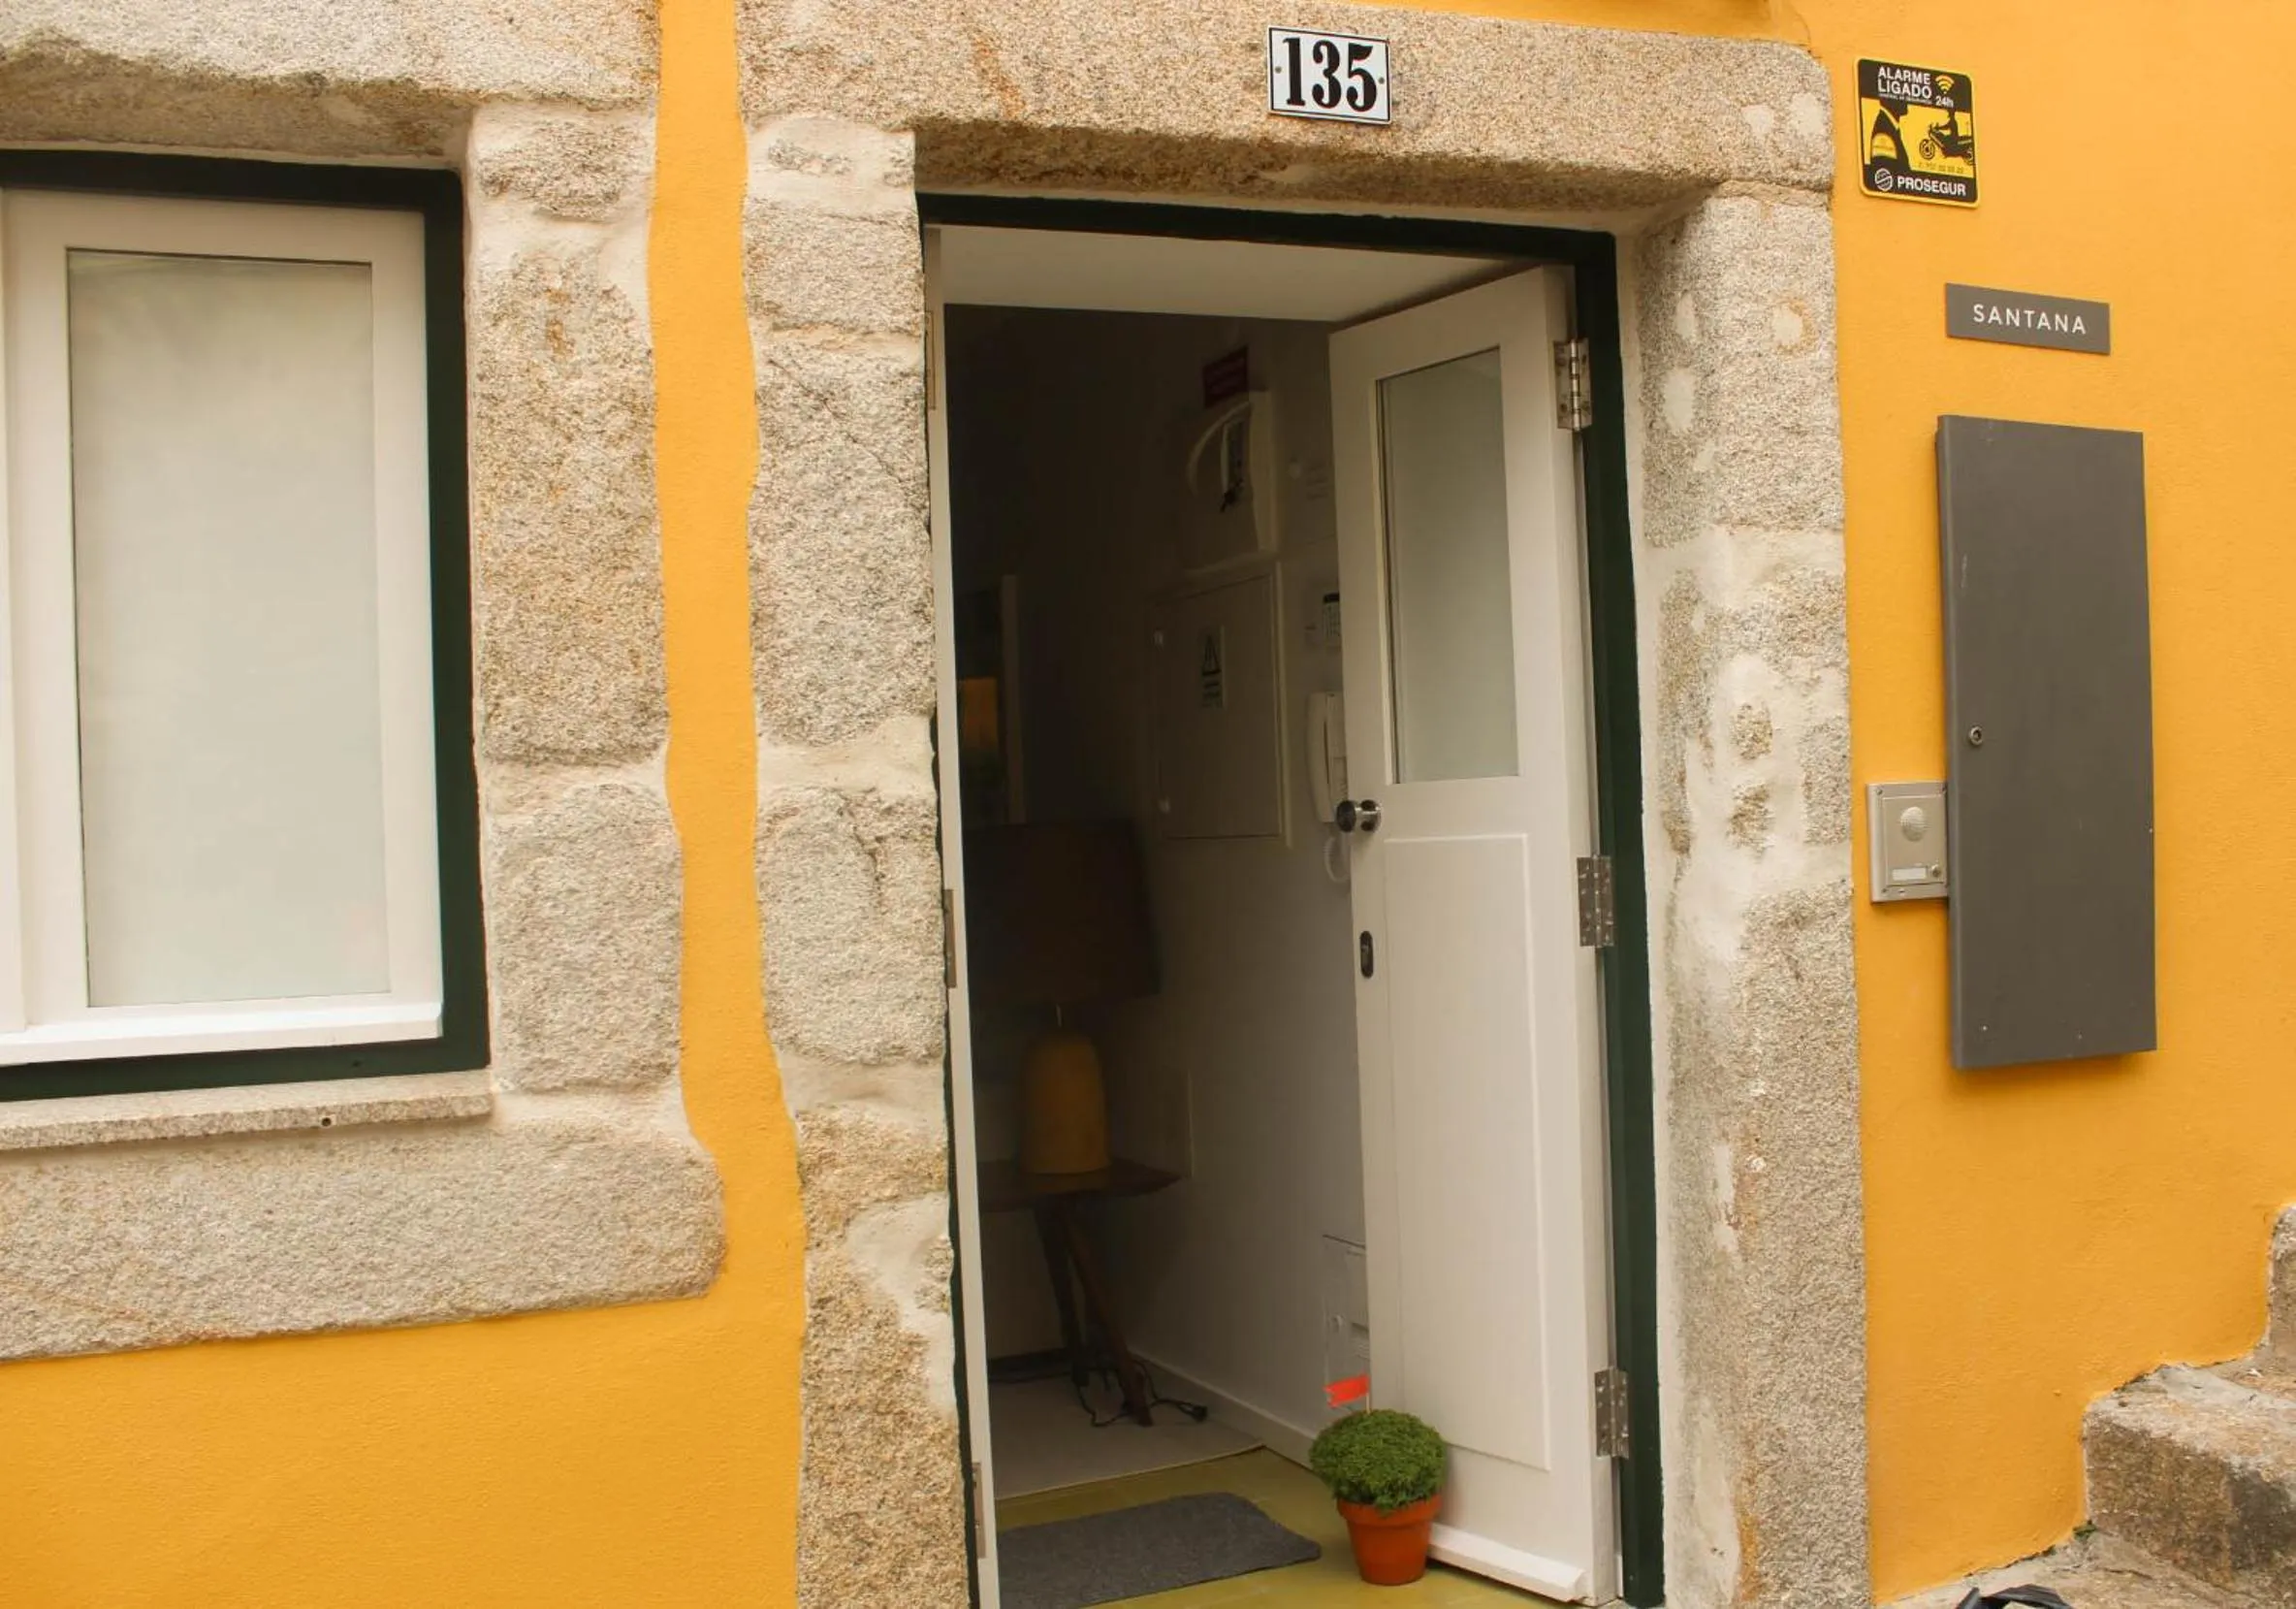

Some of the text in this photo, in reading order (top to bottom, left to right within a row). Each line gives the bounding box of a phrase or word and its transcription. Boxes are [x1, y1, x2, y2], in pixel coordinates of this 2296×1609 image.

[1283, 37, 1378, 113] 135
[1878, 66, 1931, 85] ALARME
[1877, 78, 1932, 99] LIGADO
[1897, 176, 1966, 197] PROSEGUR
[1972, 303, 2087, 335] SANTANA
